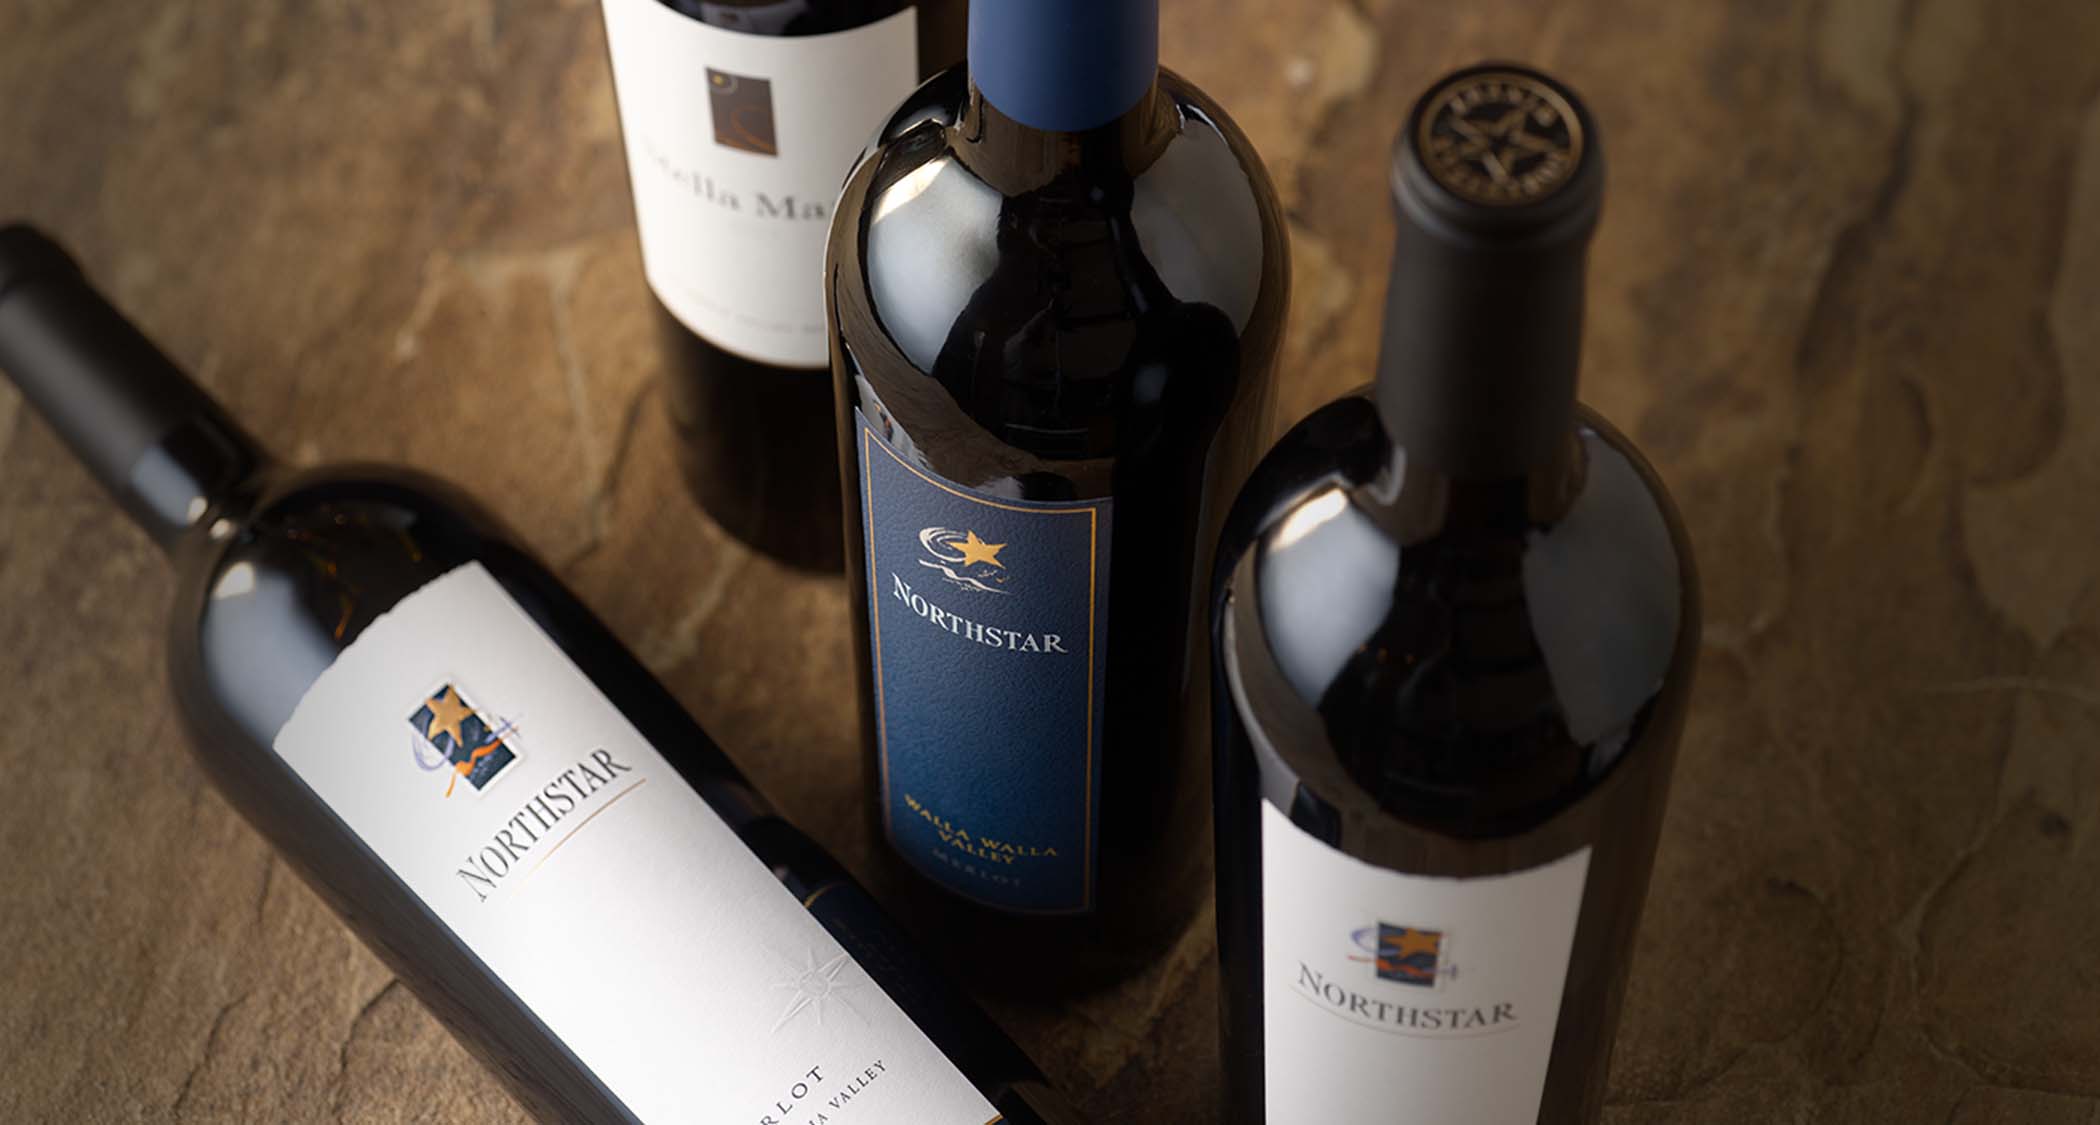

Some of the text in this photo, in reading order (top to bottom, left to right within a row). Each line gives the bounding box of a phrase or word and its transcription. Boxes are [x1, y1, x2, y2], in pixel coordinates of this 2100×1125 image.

[754, 190, 833, 221] Ma
[891, 572, 1068, 653] NORTHSTAR
[455, 747, 632, 902] NORTHSTAR
[903, 793, 1059, 857] WALLA WALLA
[938, 830, 1015, 865] VALLEY
[1297, 961, 1518, 1031] NORTHSTAR
[828, 1059, 887, 1110] VALLEY
